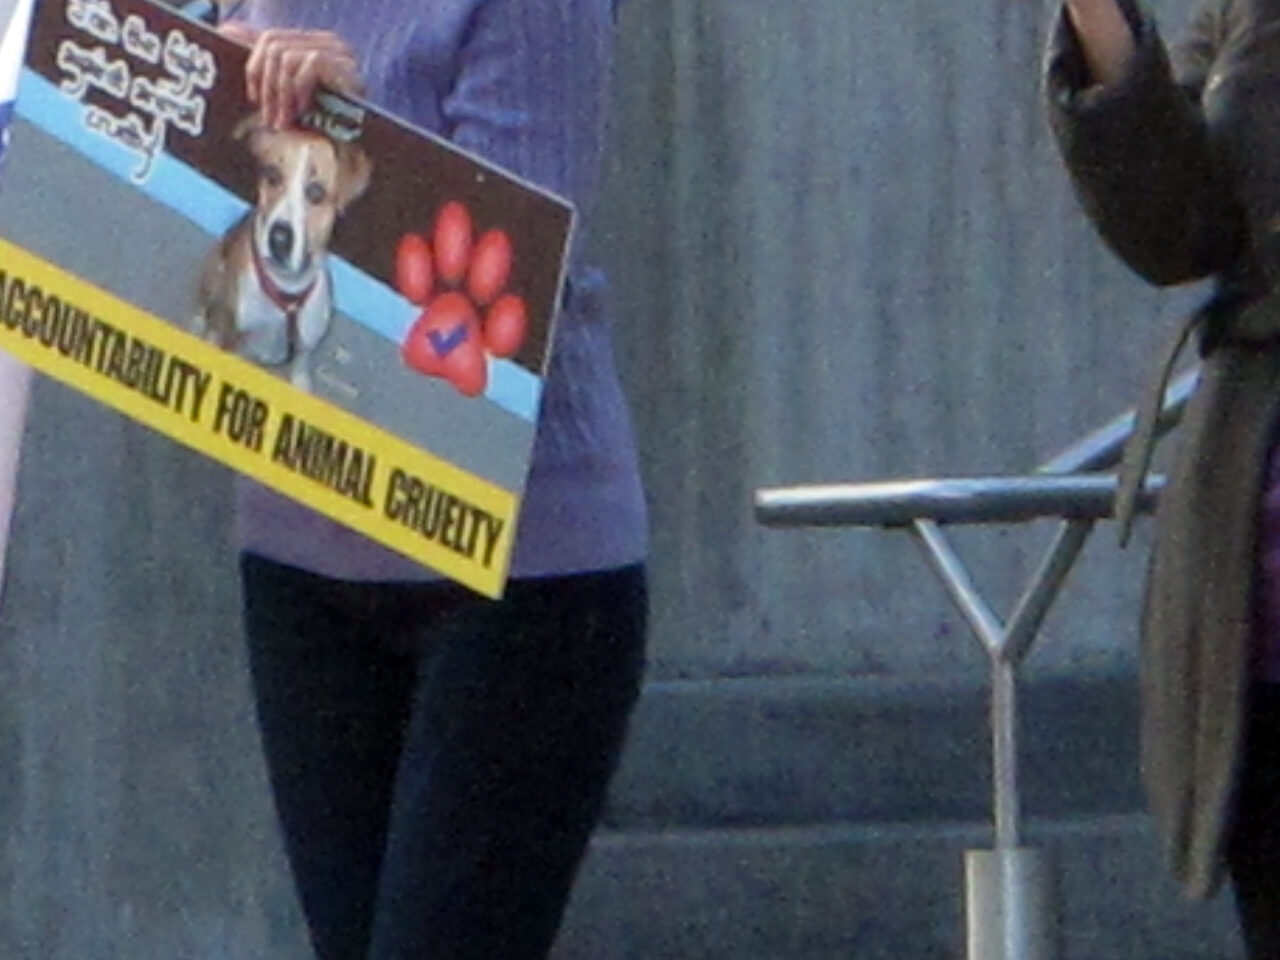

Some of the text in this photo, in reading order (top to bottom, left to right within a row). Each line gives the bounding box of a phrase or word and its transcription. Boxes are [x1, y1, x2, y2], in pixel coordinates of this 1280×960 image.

[214, 381, 269, 453] FOR
[271, 414, 376, 509] ANIMAL
[385, 469, 505, 569] CRUELTY
